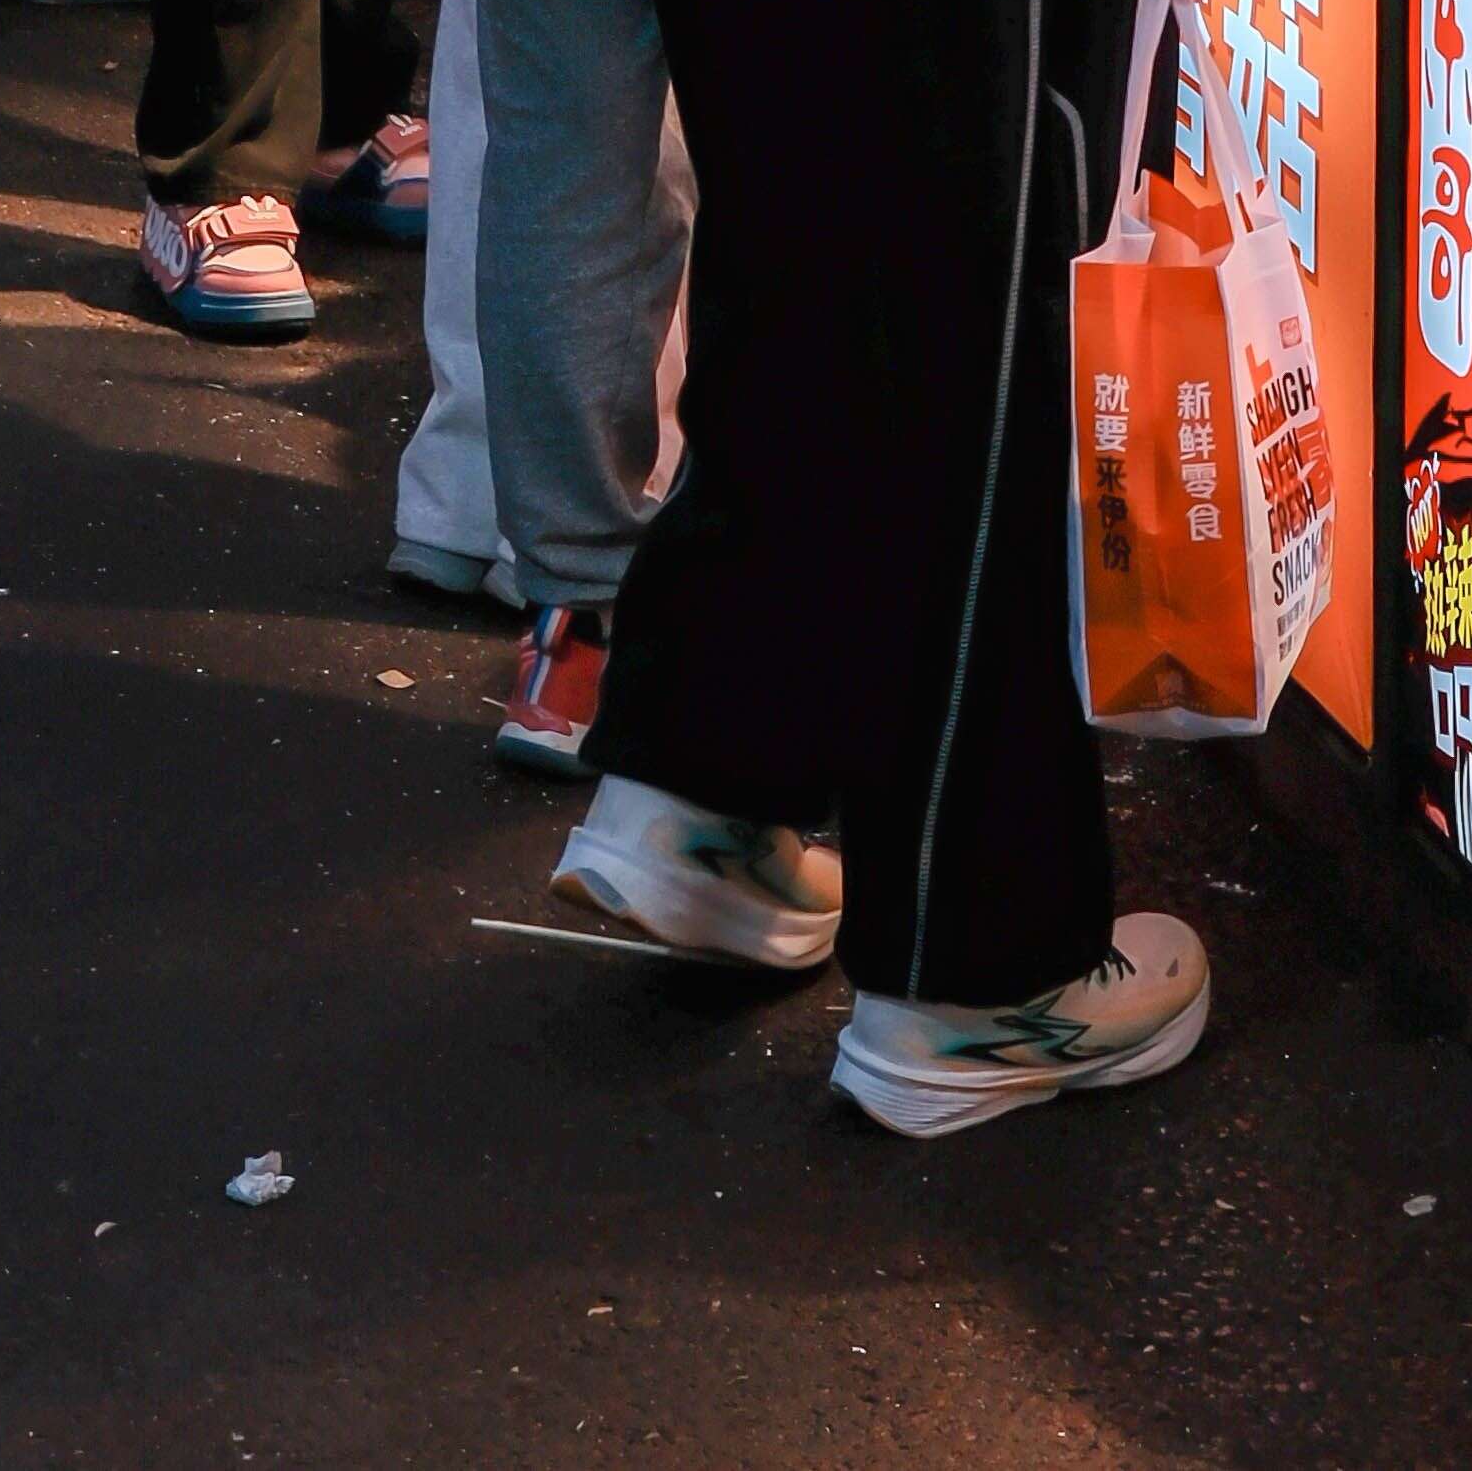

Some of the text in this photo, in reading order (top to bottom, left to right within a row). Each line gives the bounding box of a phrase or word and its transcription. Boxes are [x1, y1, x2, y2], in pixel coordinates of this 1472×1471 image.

[1094, 373, 1130, 572] 就要来伊份
[1177, 380, 1223, 541] 新鲜零食
